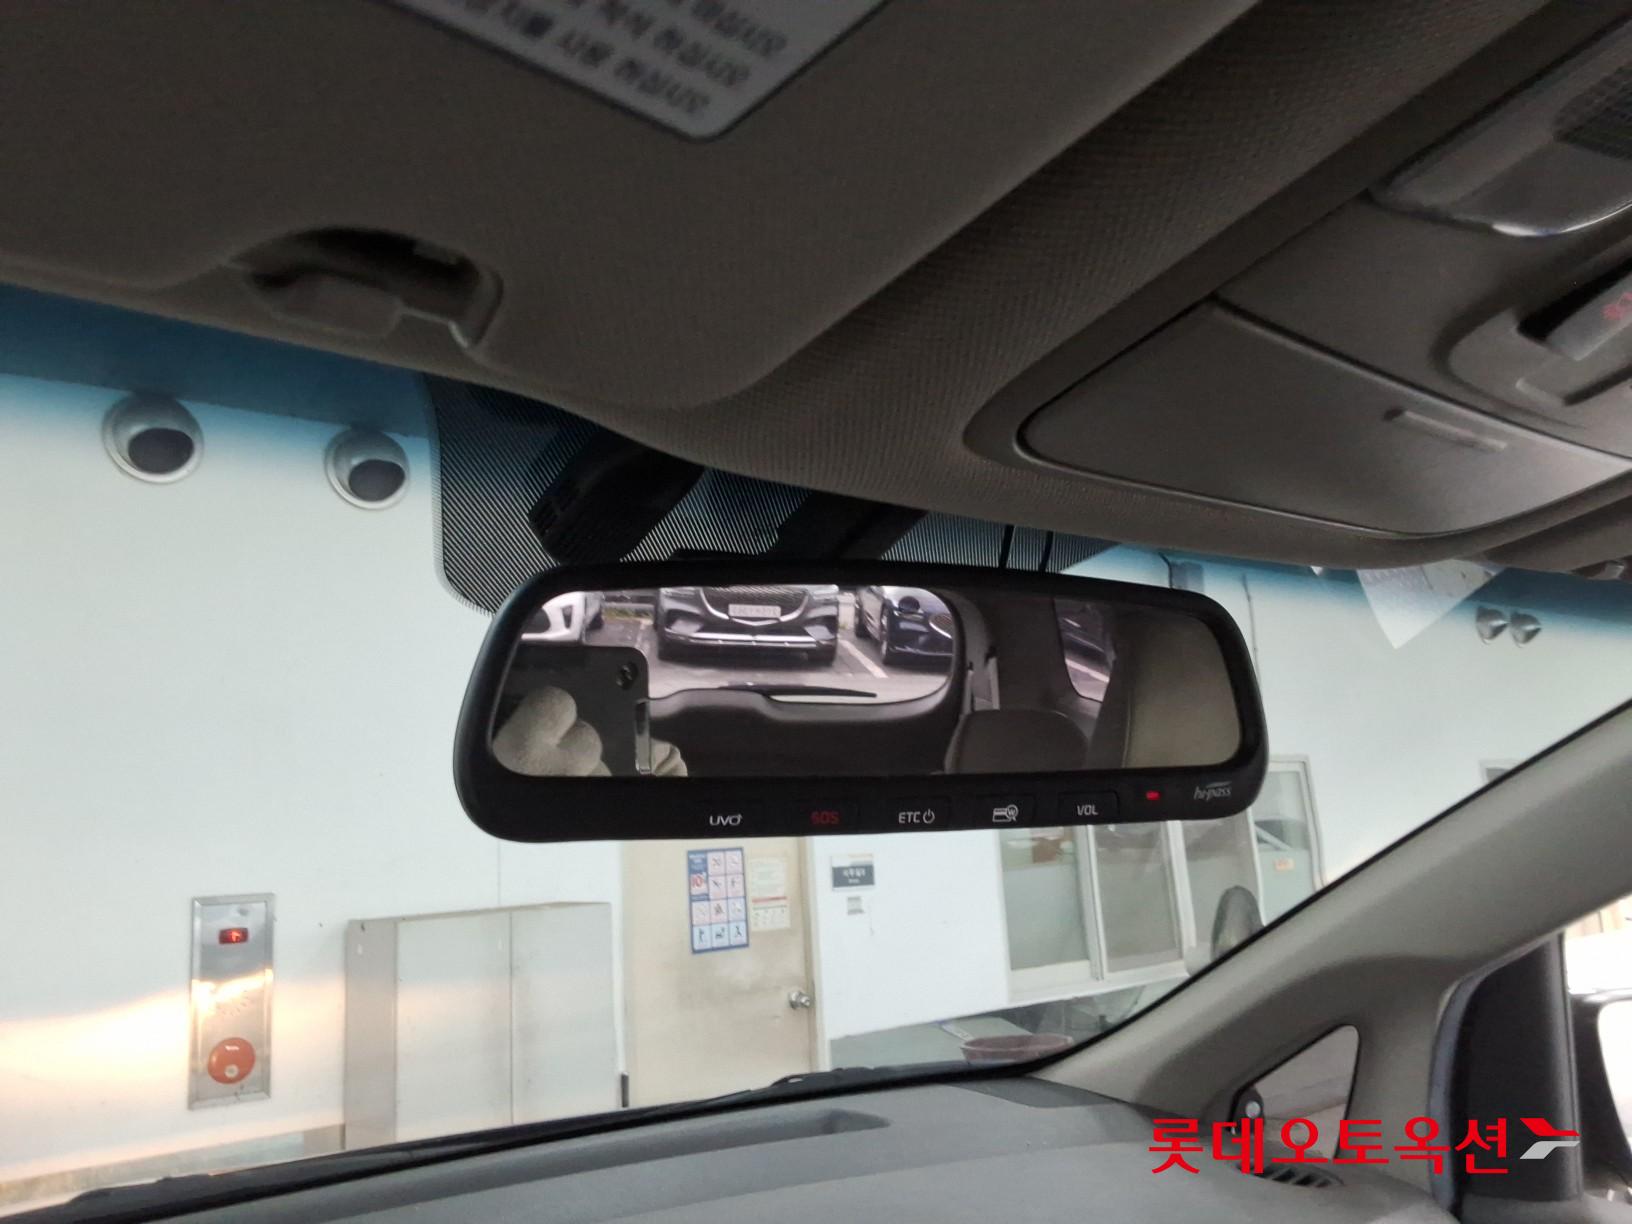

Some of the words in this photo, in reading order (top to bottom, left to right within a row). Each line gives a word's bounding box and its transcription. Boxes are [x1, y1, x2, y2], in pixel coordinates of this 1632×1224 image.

[1076, 804, 1099, 817] VOL
[709, 813, 743, 826] UVO
[811, 811, 840, 825] SOS
[898, 811, 921, 824] ETC
